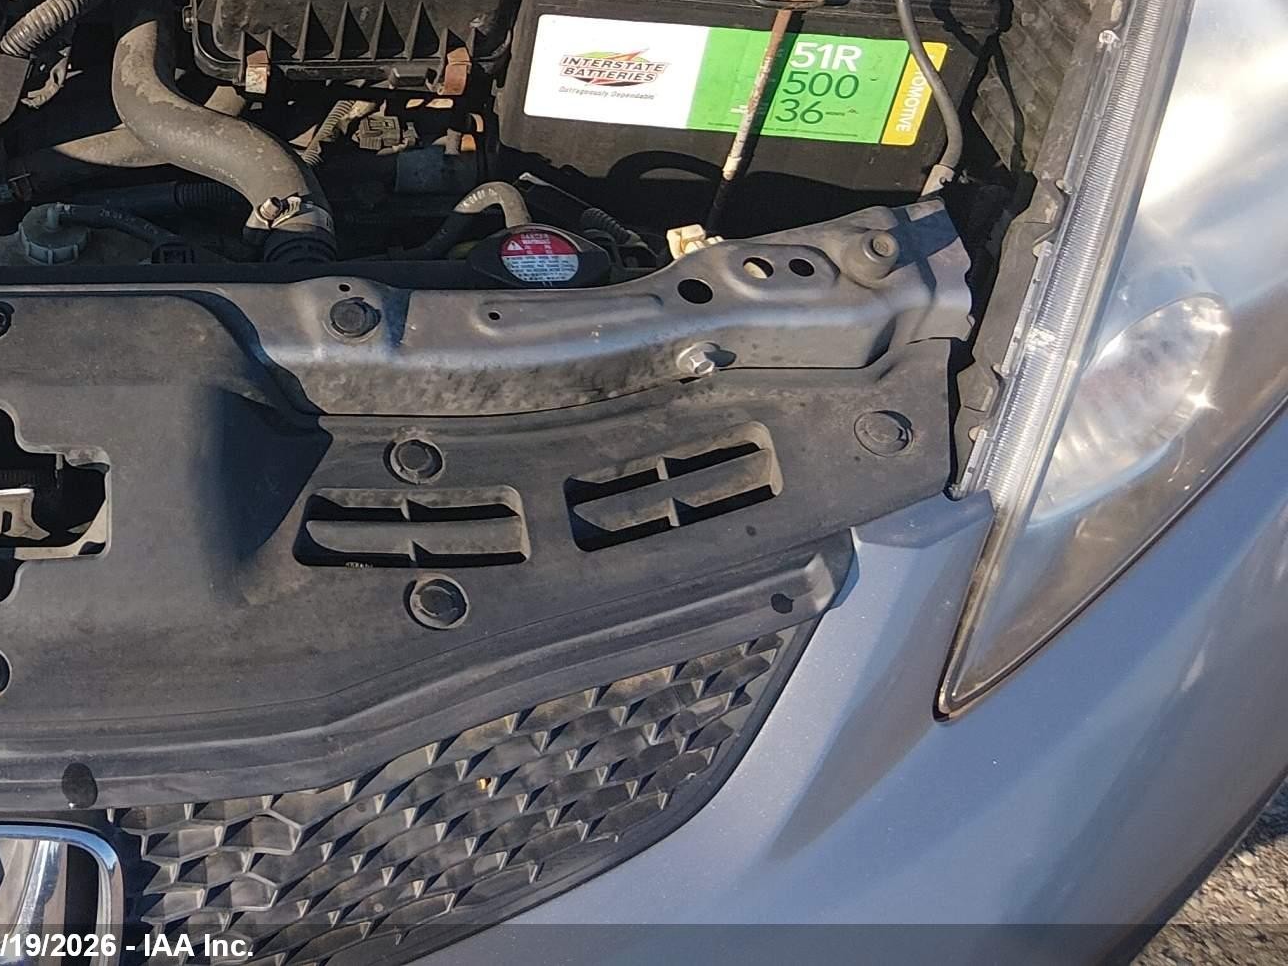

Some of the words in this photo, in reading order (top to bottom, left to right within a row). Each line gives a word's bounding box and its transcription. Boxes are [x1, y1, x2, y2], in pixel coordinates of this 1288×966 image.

[561, 56, 666, 72] INTERSTATE
[789, 41, 862, 71] 51R
[563, 67, 657, 82] BATTERIES
[782, 70, 860, 99] 500
[774, 98, 824, 125] 36
[895, 70, 928, 133] OMOTIVE
